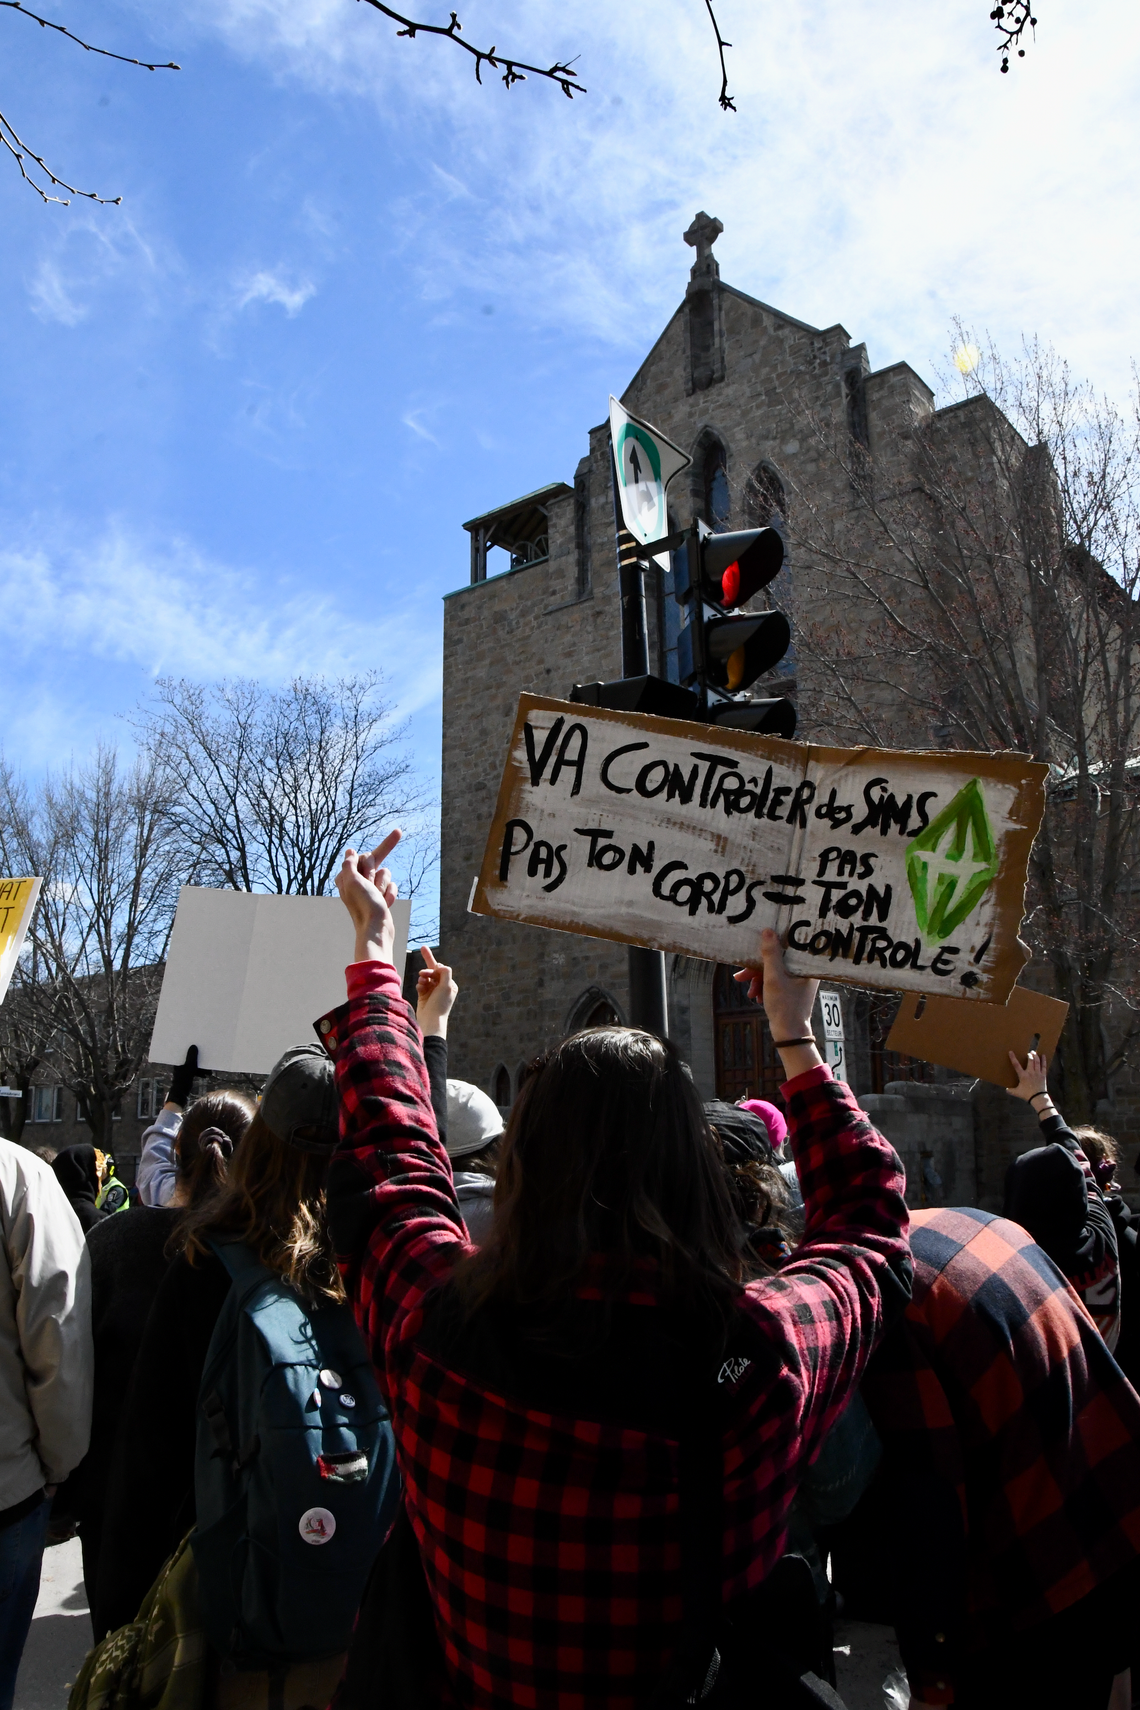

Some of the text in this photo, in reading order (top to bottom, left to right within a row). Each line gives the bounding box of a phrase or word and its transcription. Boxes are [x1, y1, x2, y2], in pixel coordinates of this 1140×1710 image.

[524, 716, 588, 797] VA
[499, 819, 568, 893] PAS
[573, 828, 656, 875] TON
[652, 861, 767, 924] CORPS
[816, 846, 879, 880] PAS
[811, 880, 893, 923] TON
[824, 1002, 840, 1027] 30
